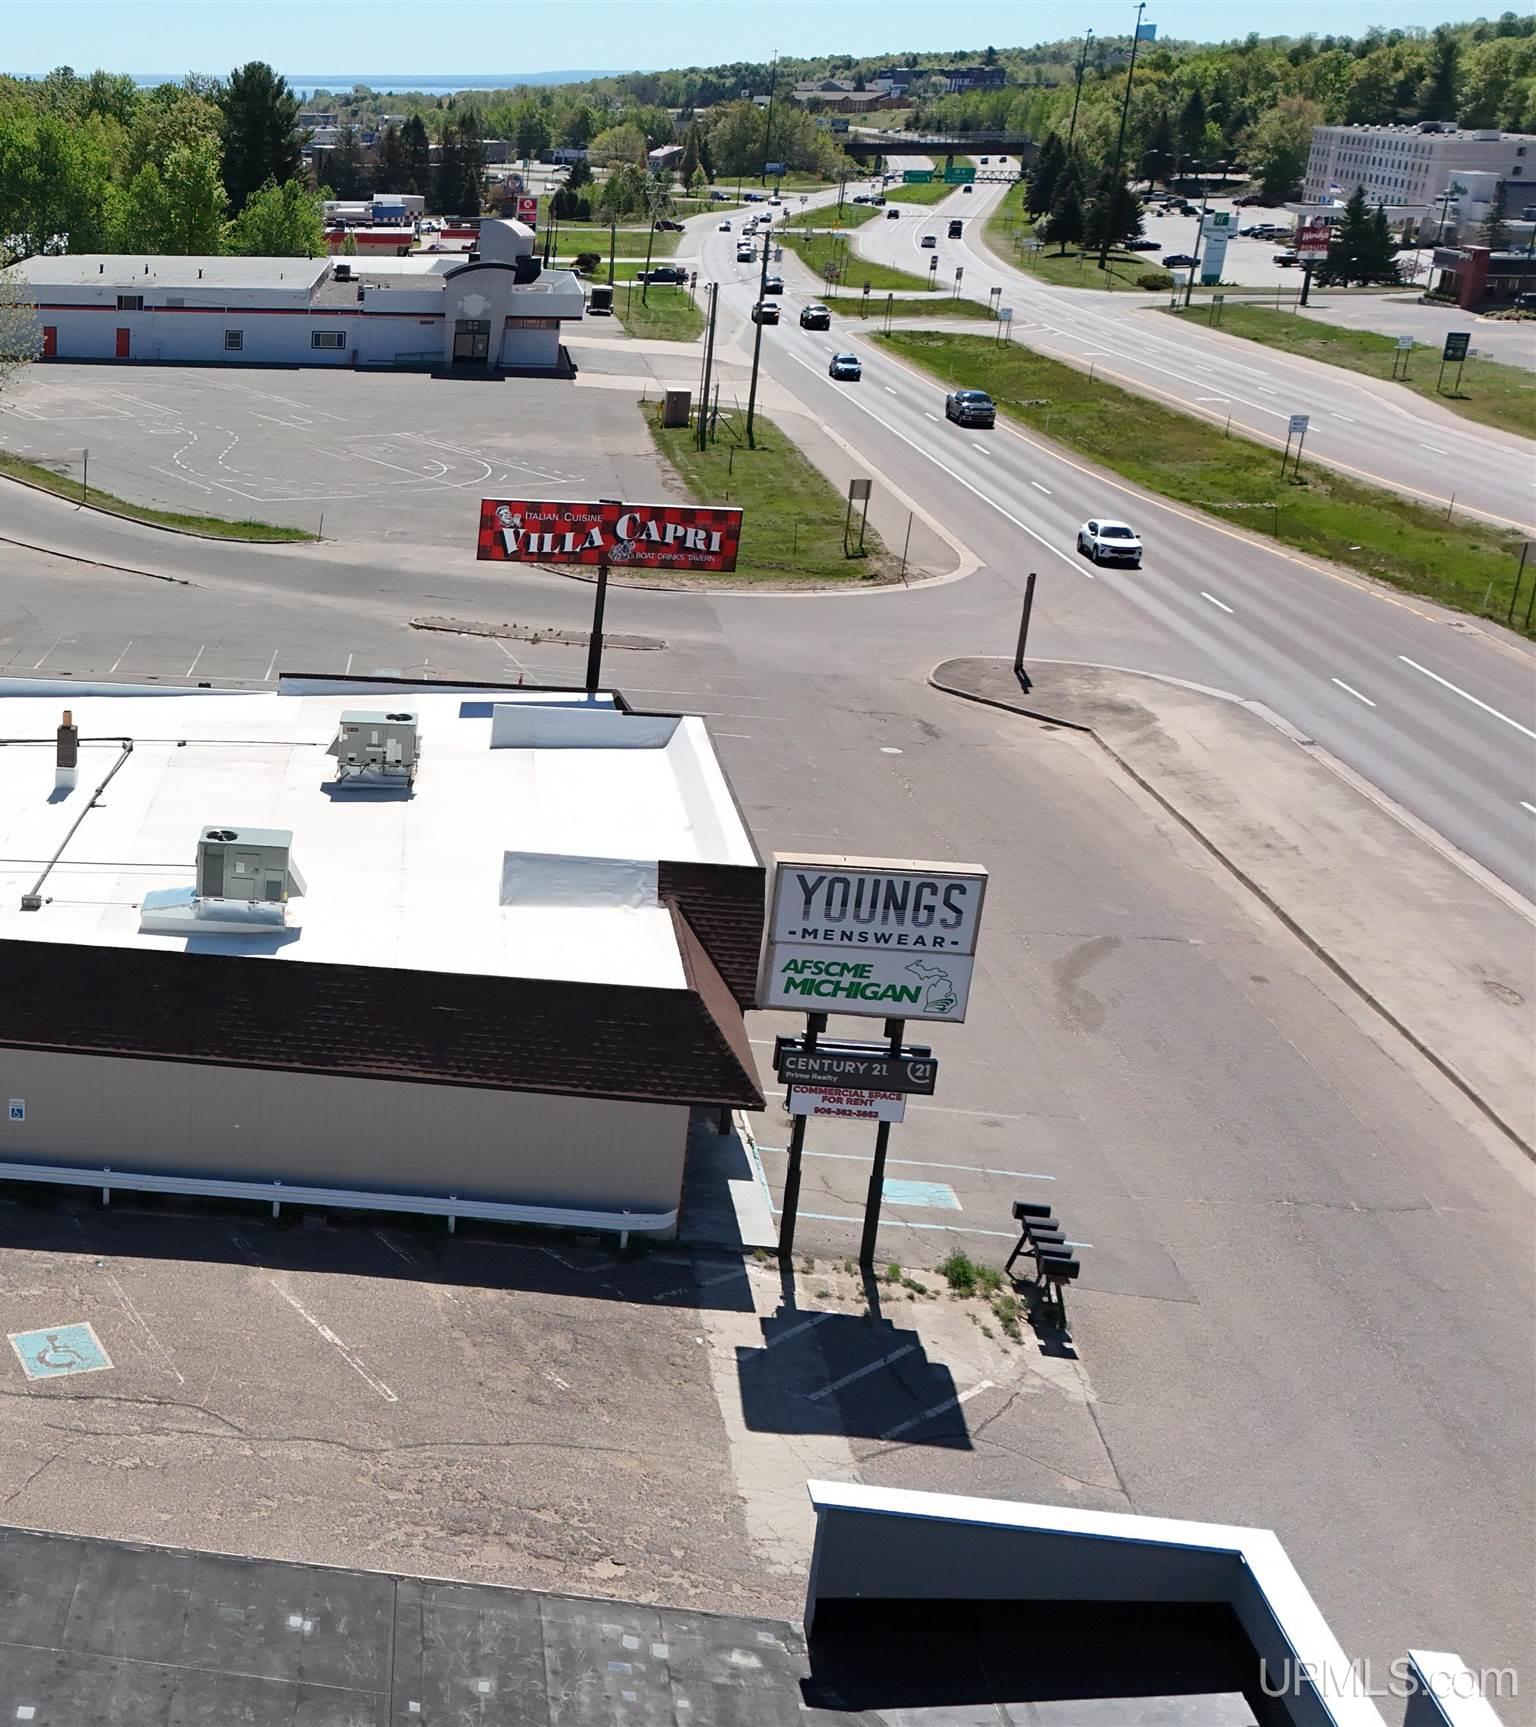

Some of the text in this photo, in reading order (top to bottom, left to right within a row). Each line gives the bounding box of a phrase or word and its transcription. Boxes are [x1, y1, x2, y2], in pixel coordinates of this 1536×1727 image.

[525, 511, 604, 522] ITALIAN CUISINE
[501, 512, 723, 554] VILLA CAPRI
[635, 552, 716, 562] BOAT DRINKS TAVERN
[796, 874, 967, 930] YOUNGS
[781, 958, 874, 980] AFSCME
[783, 977, 923, 1003] MICHIGAN
[785, 1057, 889, 1076] CENTURY 21
[914, 1064, 930, 1077] 21
[785, 1071, 838, 1083] Prime Realty
[793, 1085, 903, 1102] COMMERCIAL SPACE
[821, 1096, 875, 1107] FOR RENT
